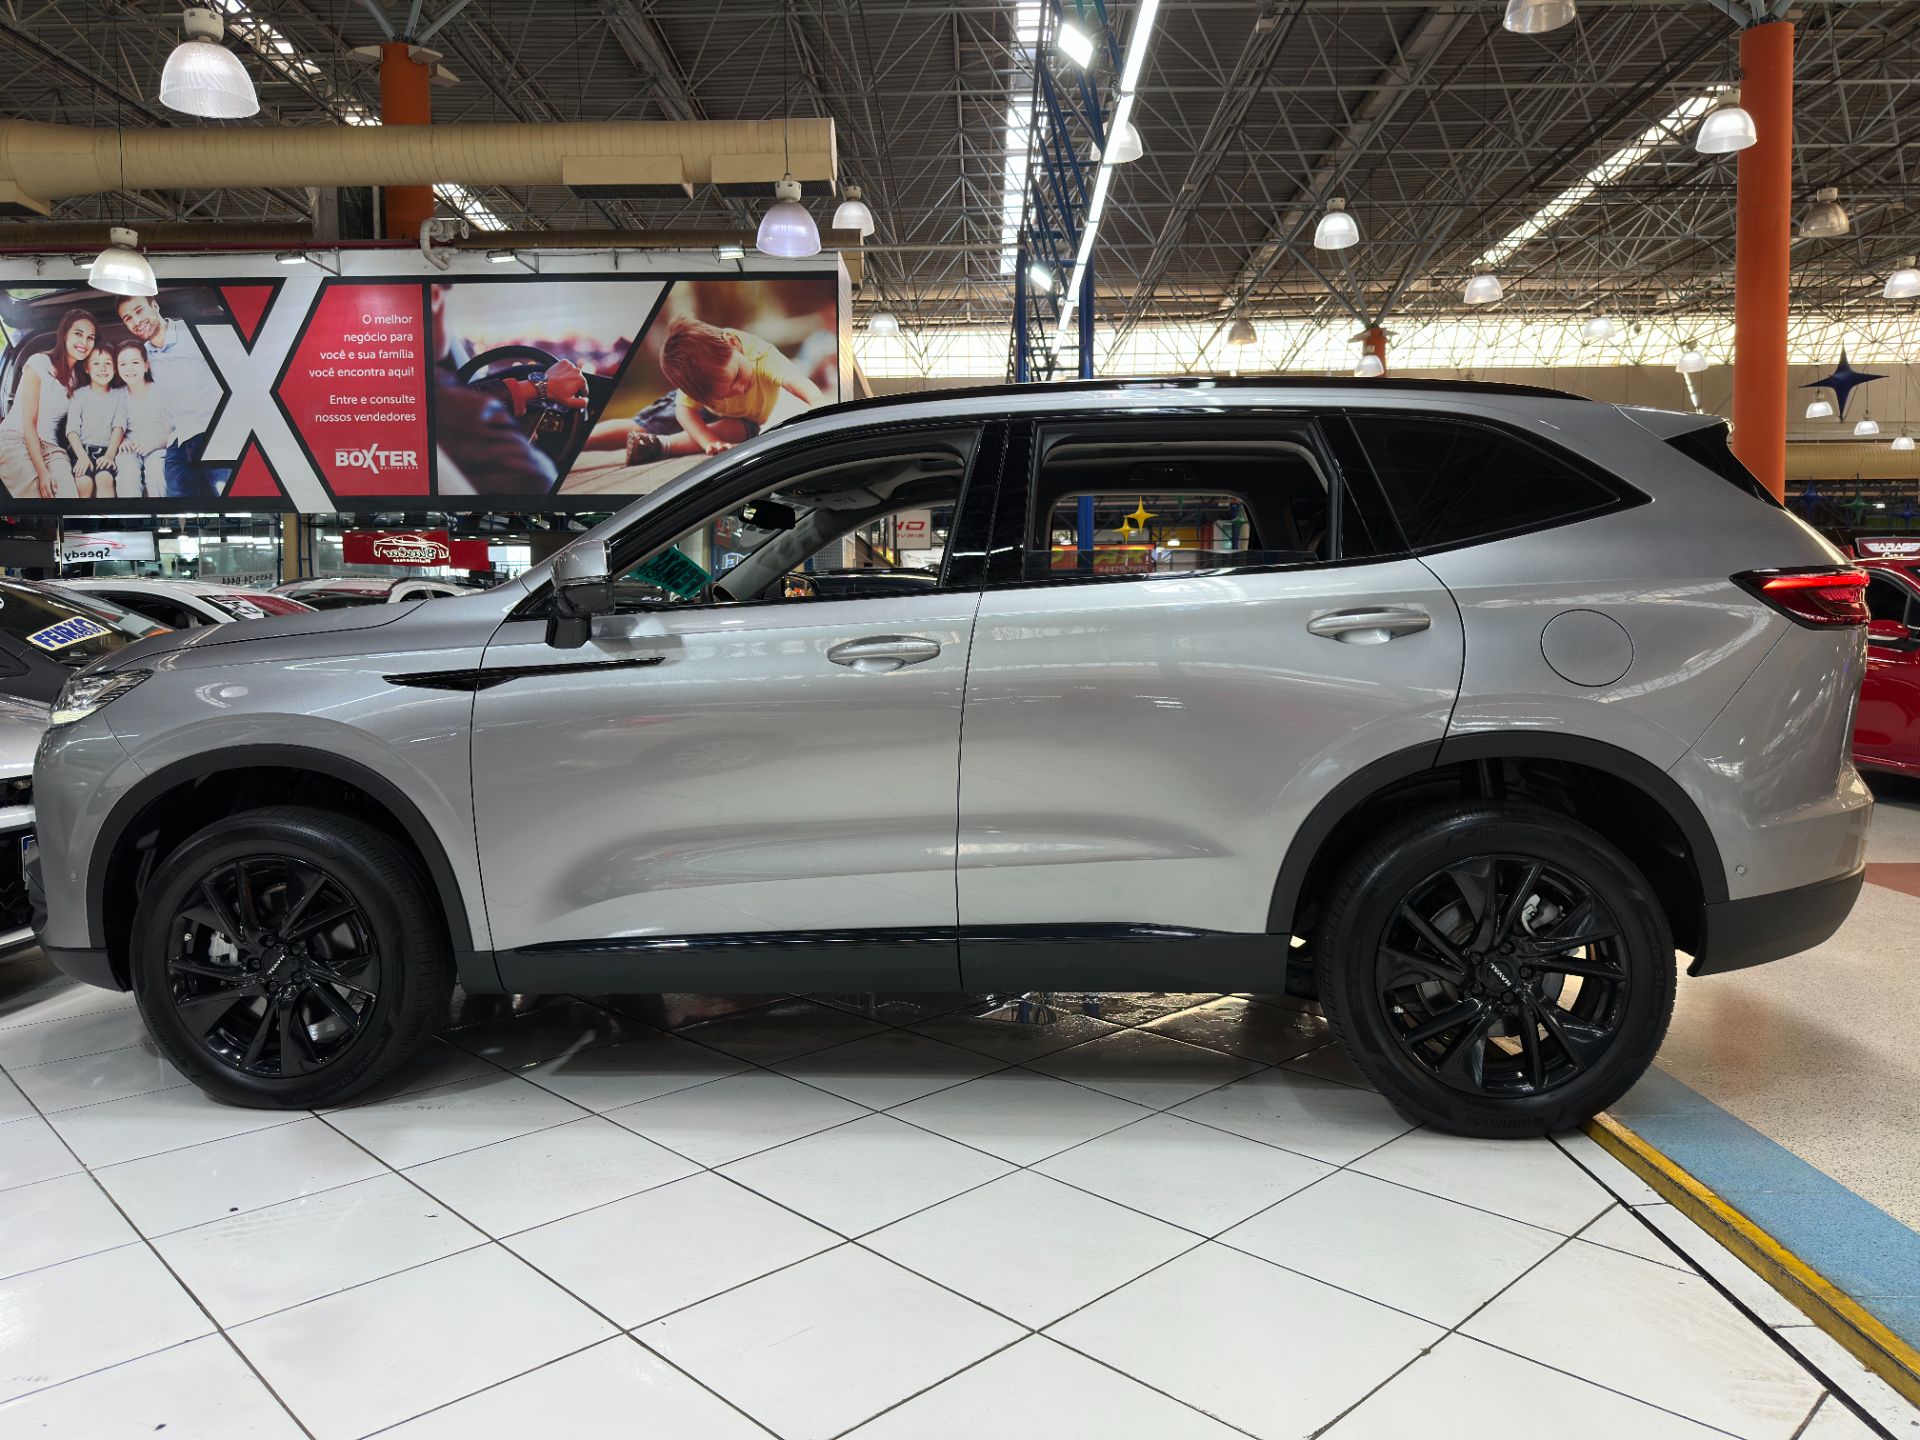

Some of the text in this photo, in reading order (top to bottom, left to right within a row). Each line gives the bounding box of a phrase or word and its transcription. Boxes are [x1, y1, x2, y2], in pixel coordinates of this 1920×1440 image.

[362, 313, 413, 325] O melhor
[343, 332, 414, 345] negócio para
[320, 349, 414, 360] você e sua família
[309, 366, 415, 379] você encontra aqui!
[329, 394, 416, 405] Entre e consulte
[315, 411, 417, 423] nossos vendedores
[335, 443, 418, 474] BOXTER
[1490, 962, 1512, 987] HAVAL
